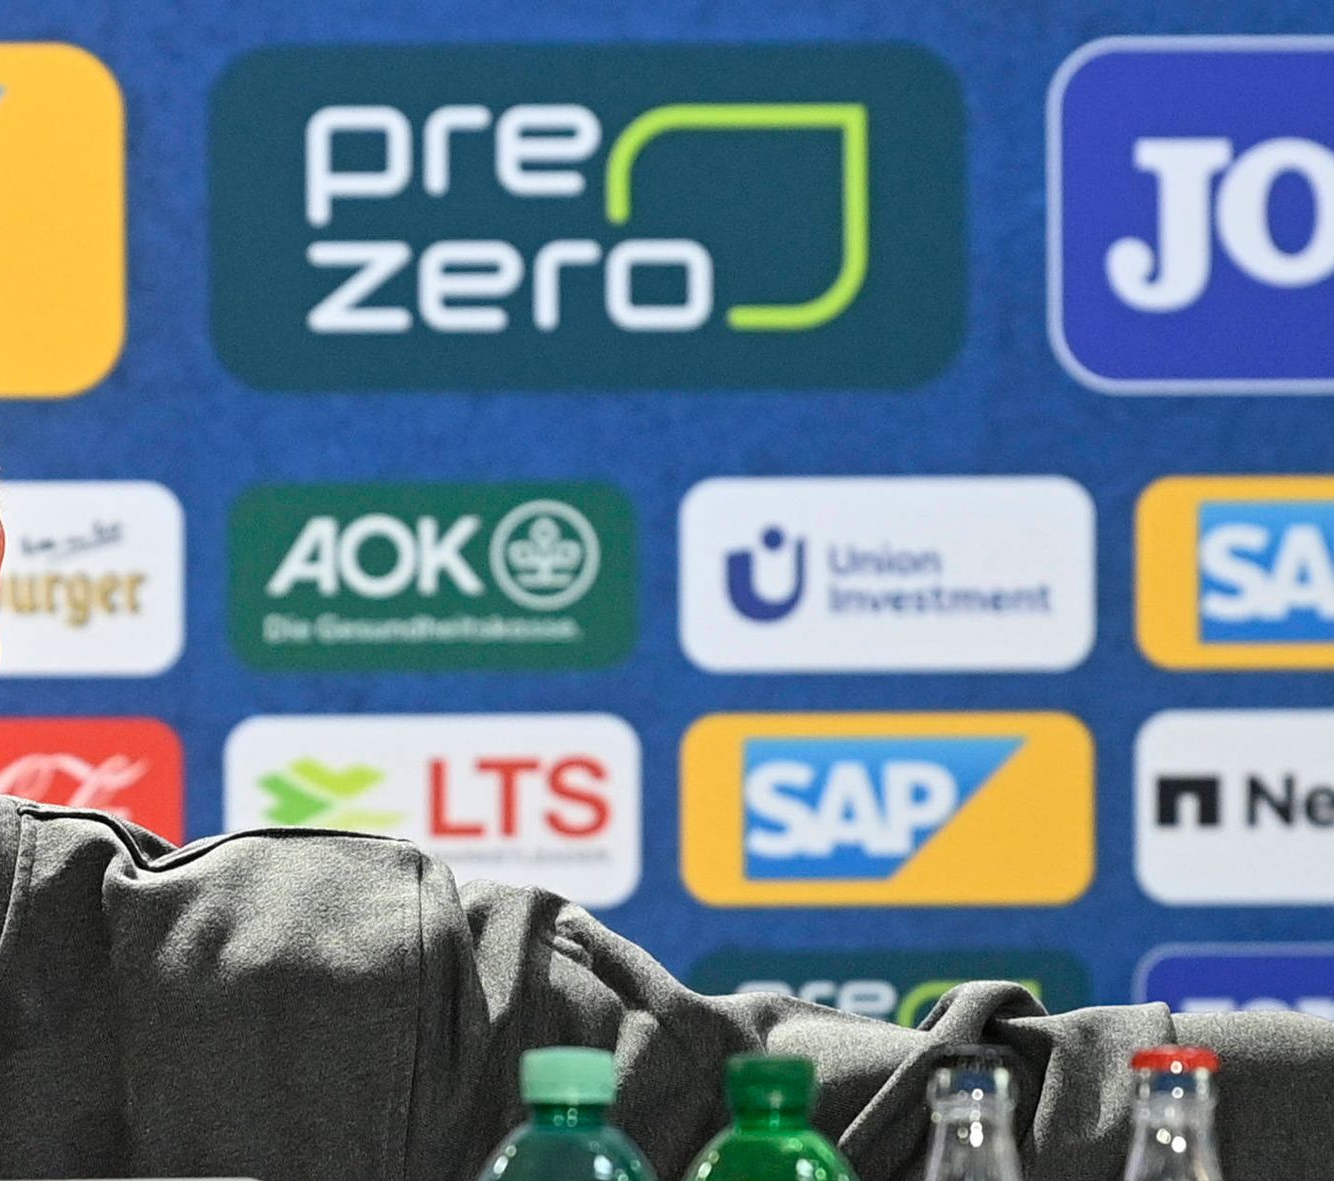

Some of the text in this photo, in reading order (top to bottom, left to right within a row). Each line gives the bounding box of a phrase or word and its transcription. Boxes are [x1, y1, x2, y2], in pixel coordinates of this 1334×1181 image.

[306, 105, 601, 227] pre
[307, 239, 713, 333] zero
[268, 513, 484, 599] AOK
[827, 543, 943, 576] Union
[827, 586, 1052, 615] Investment
[428, 756, 612, 839] LTS
[743, 760, 959, 858] SAP
